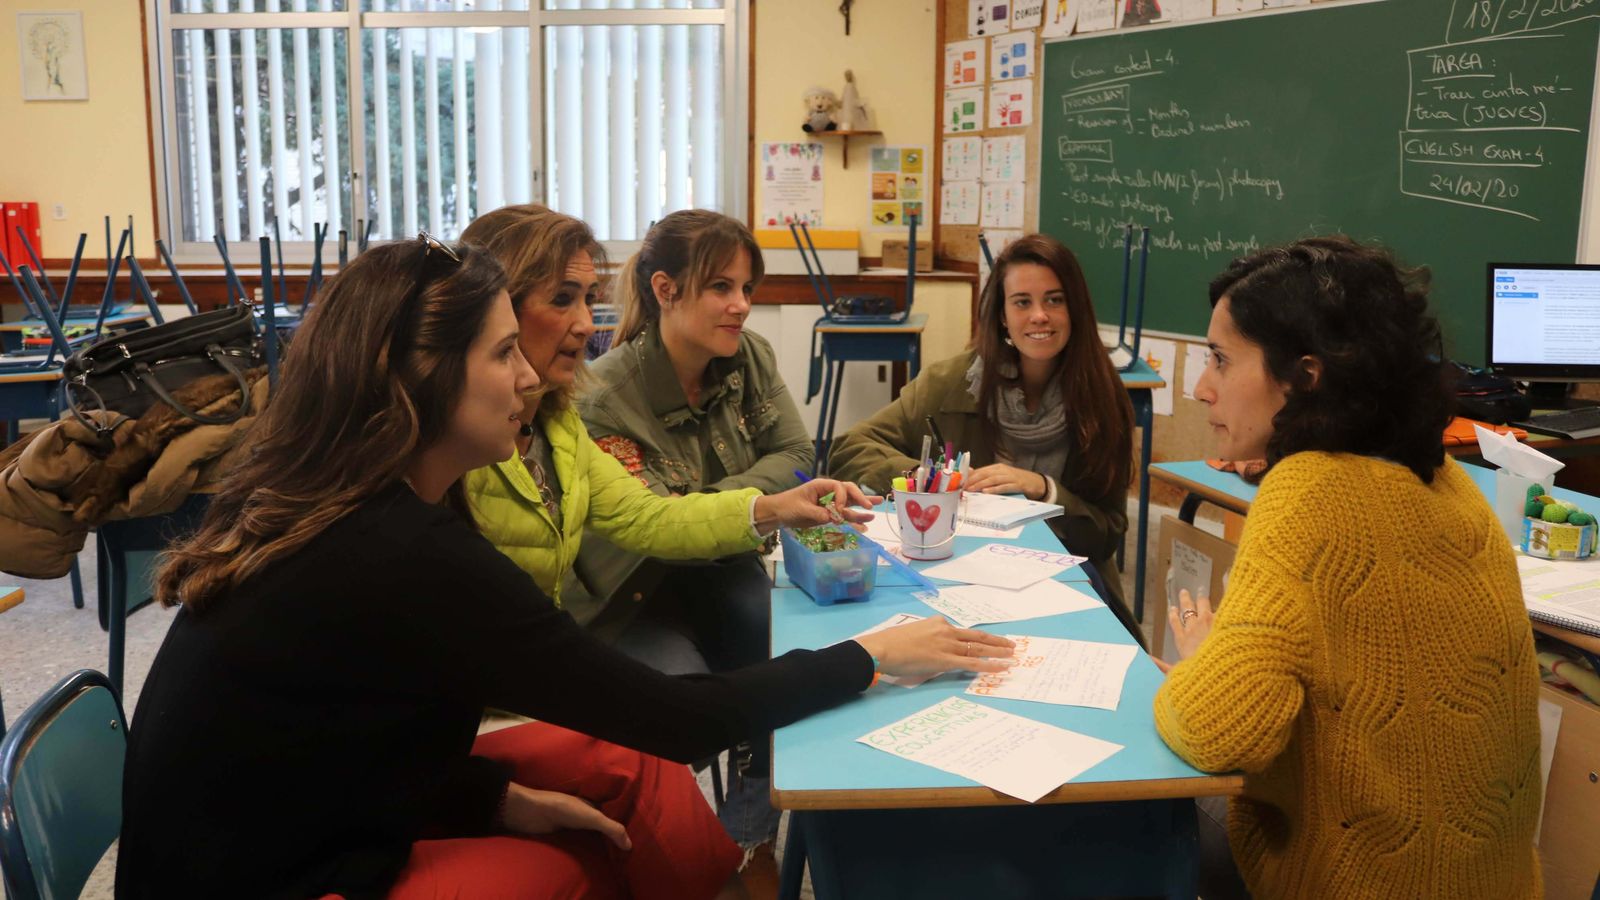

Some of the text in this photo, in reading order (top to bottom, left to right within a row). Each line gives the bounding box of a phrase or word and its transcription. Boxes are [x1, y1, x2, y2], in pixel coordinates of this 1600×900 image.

[1070, 54, 1106, 79] Exam
[1482, 72, 1530, 98] cinta
[1414, 101, 1548, 128] trica (JUEVES)
[1404, 138, 1474, 157] ENGLISH
[1429, 174, 1520, 204] 24/02/20
